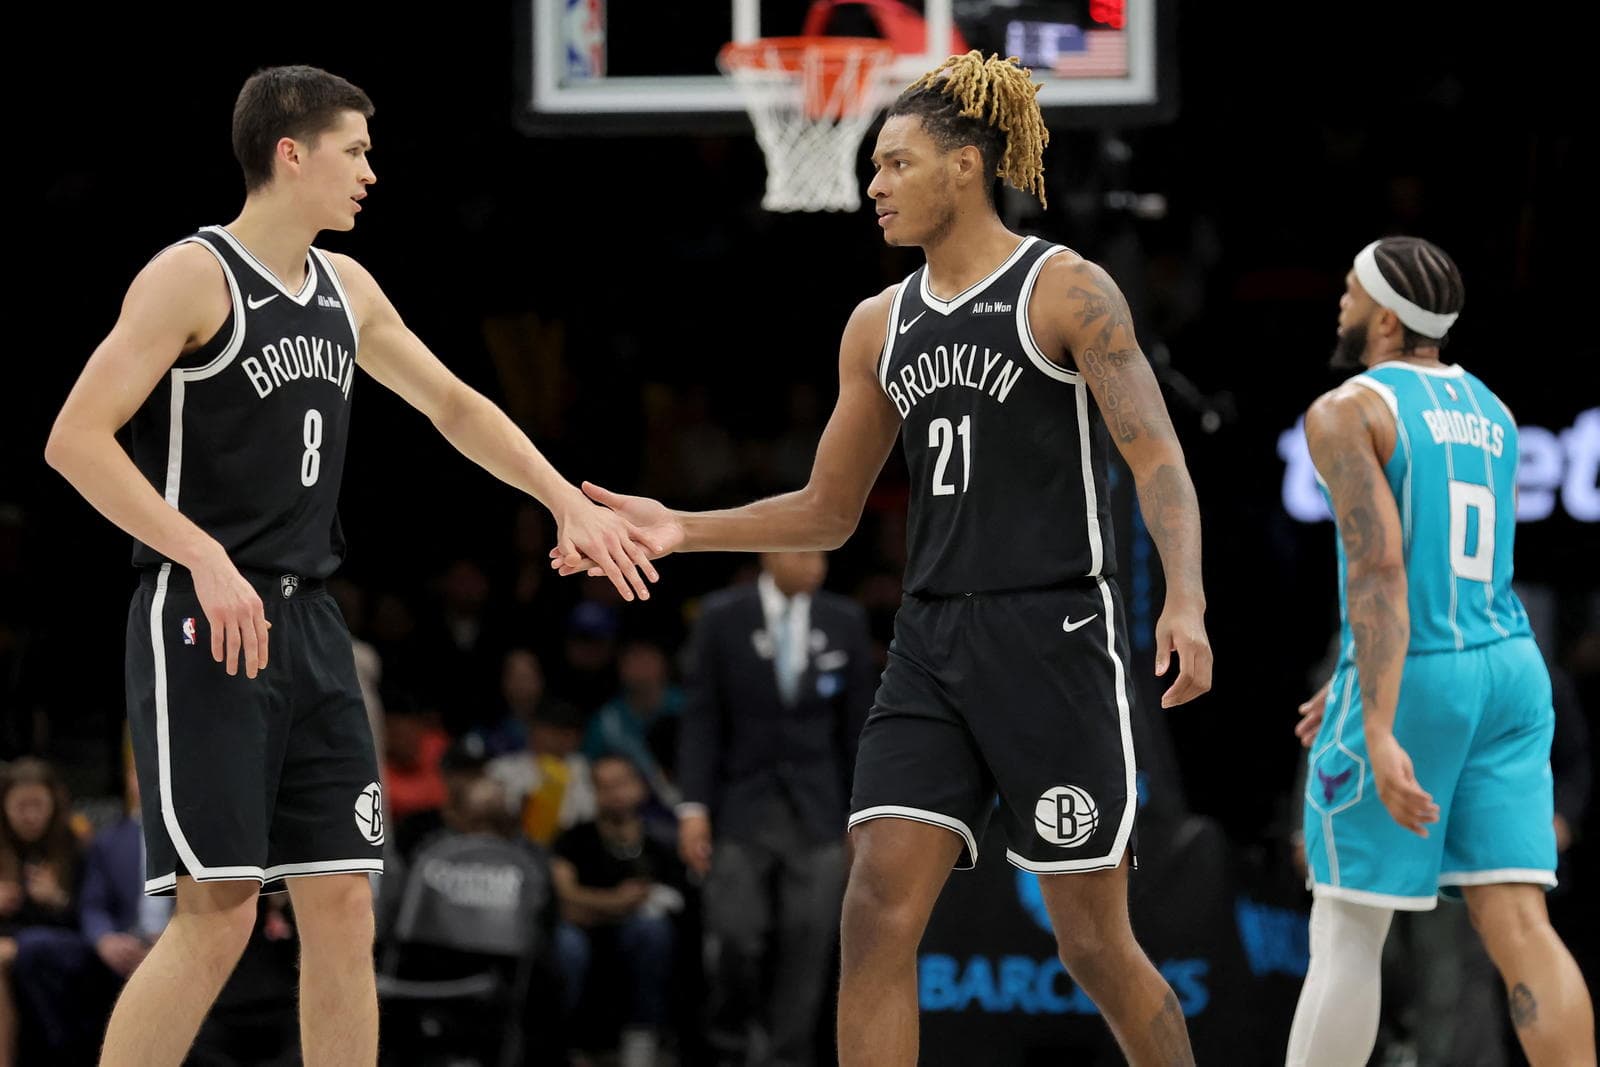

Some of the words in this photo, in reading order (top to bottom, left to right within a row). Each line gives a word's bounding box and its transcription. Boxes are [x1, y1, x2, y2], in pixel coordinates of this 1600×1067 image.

[972, 302, 984, 314] All
[984, 302, 993, 313] In
[994, 301, 1012, 313] Won
[240, 335, 355, 401] BROOKLYN
[887, 343, 1023, 420] BROOKLYN
[300, 408, 323, 488] 8
[928, 414, 971, 497] 21
[1422, 409, 1505, 459] BRIDGES
[1448, 479, 1496, 585] 0
[1056, 793, 1078, 840] B
[918, 952, 1211, 1018] BARCS
